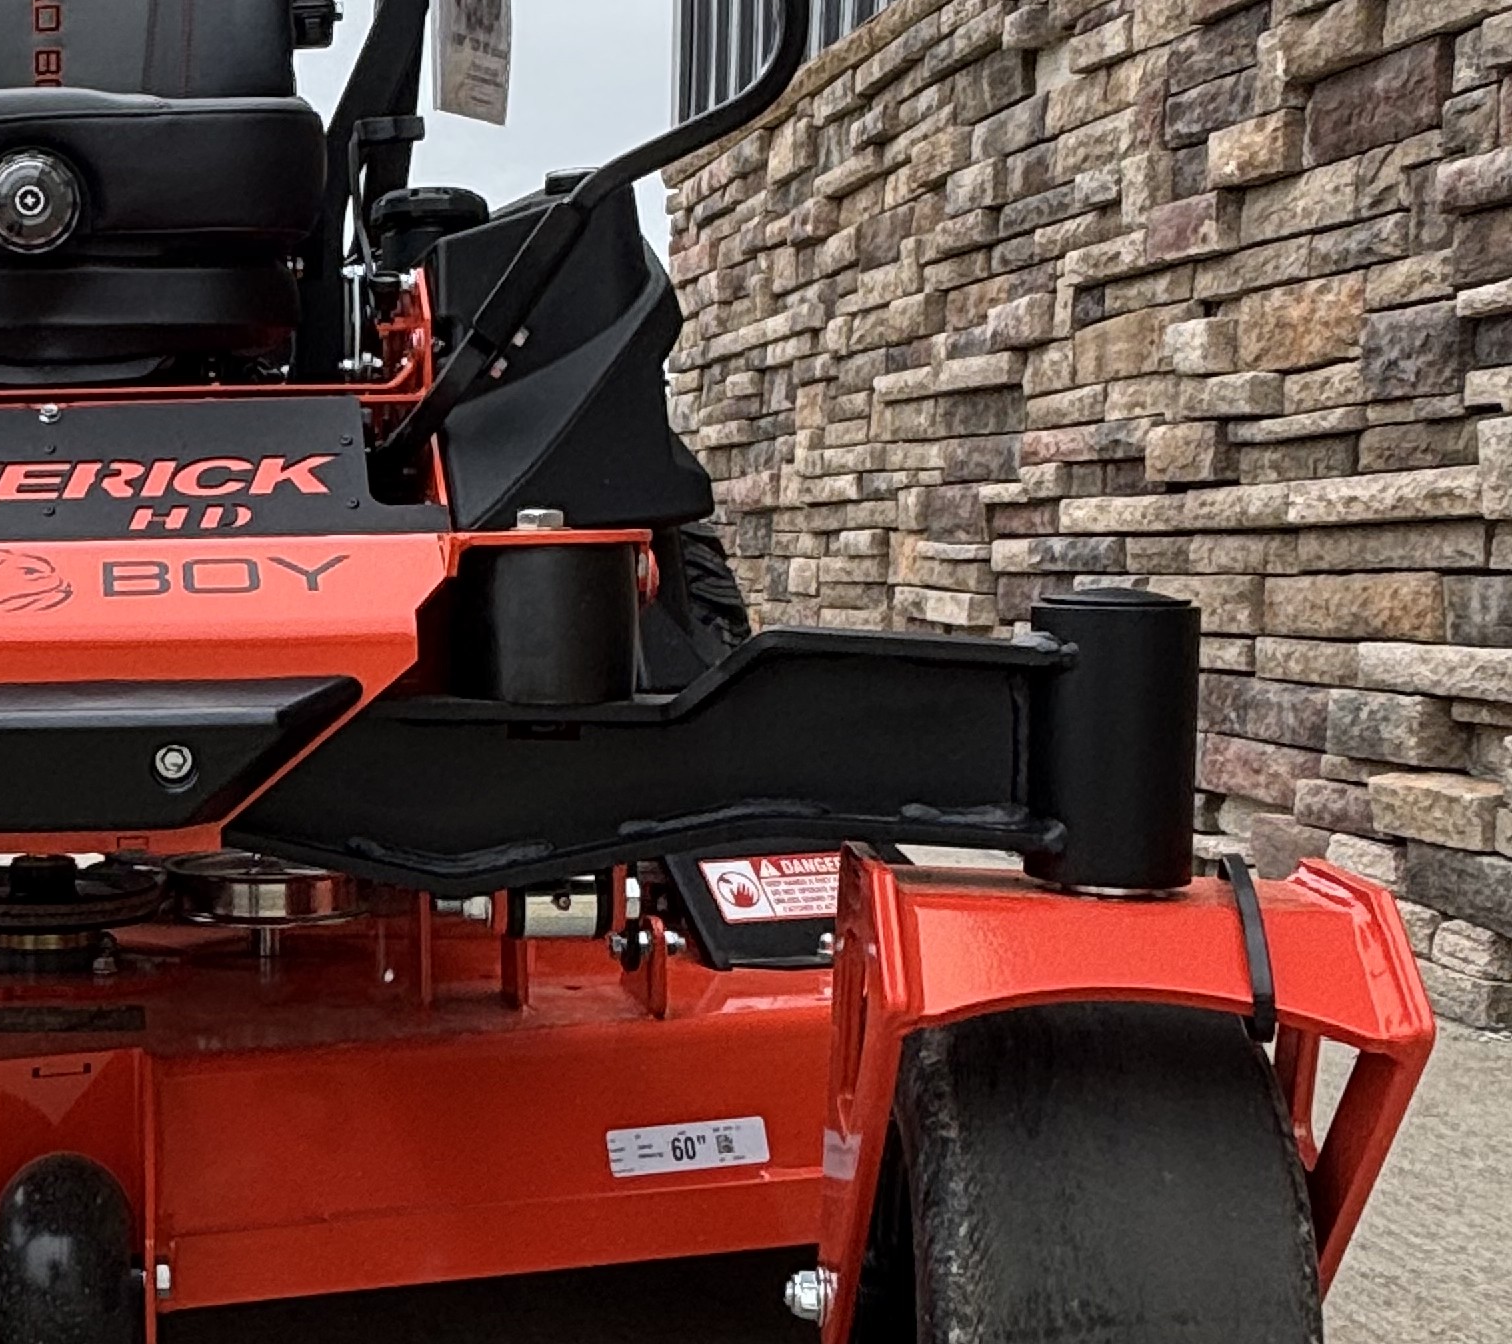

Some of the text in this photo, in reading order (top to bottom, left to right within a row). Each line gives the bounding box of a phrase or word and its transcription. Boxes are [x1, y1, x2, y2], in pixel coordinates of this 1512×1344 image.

[128, 504, 253, 531] HD
[102, 556, 352, 598] BOY
[670, 1134, 706, 1162] 60"
